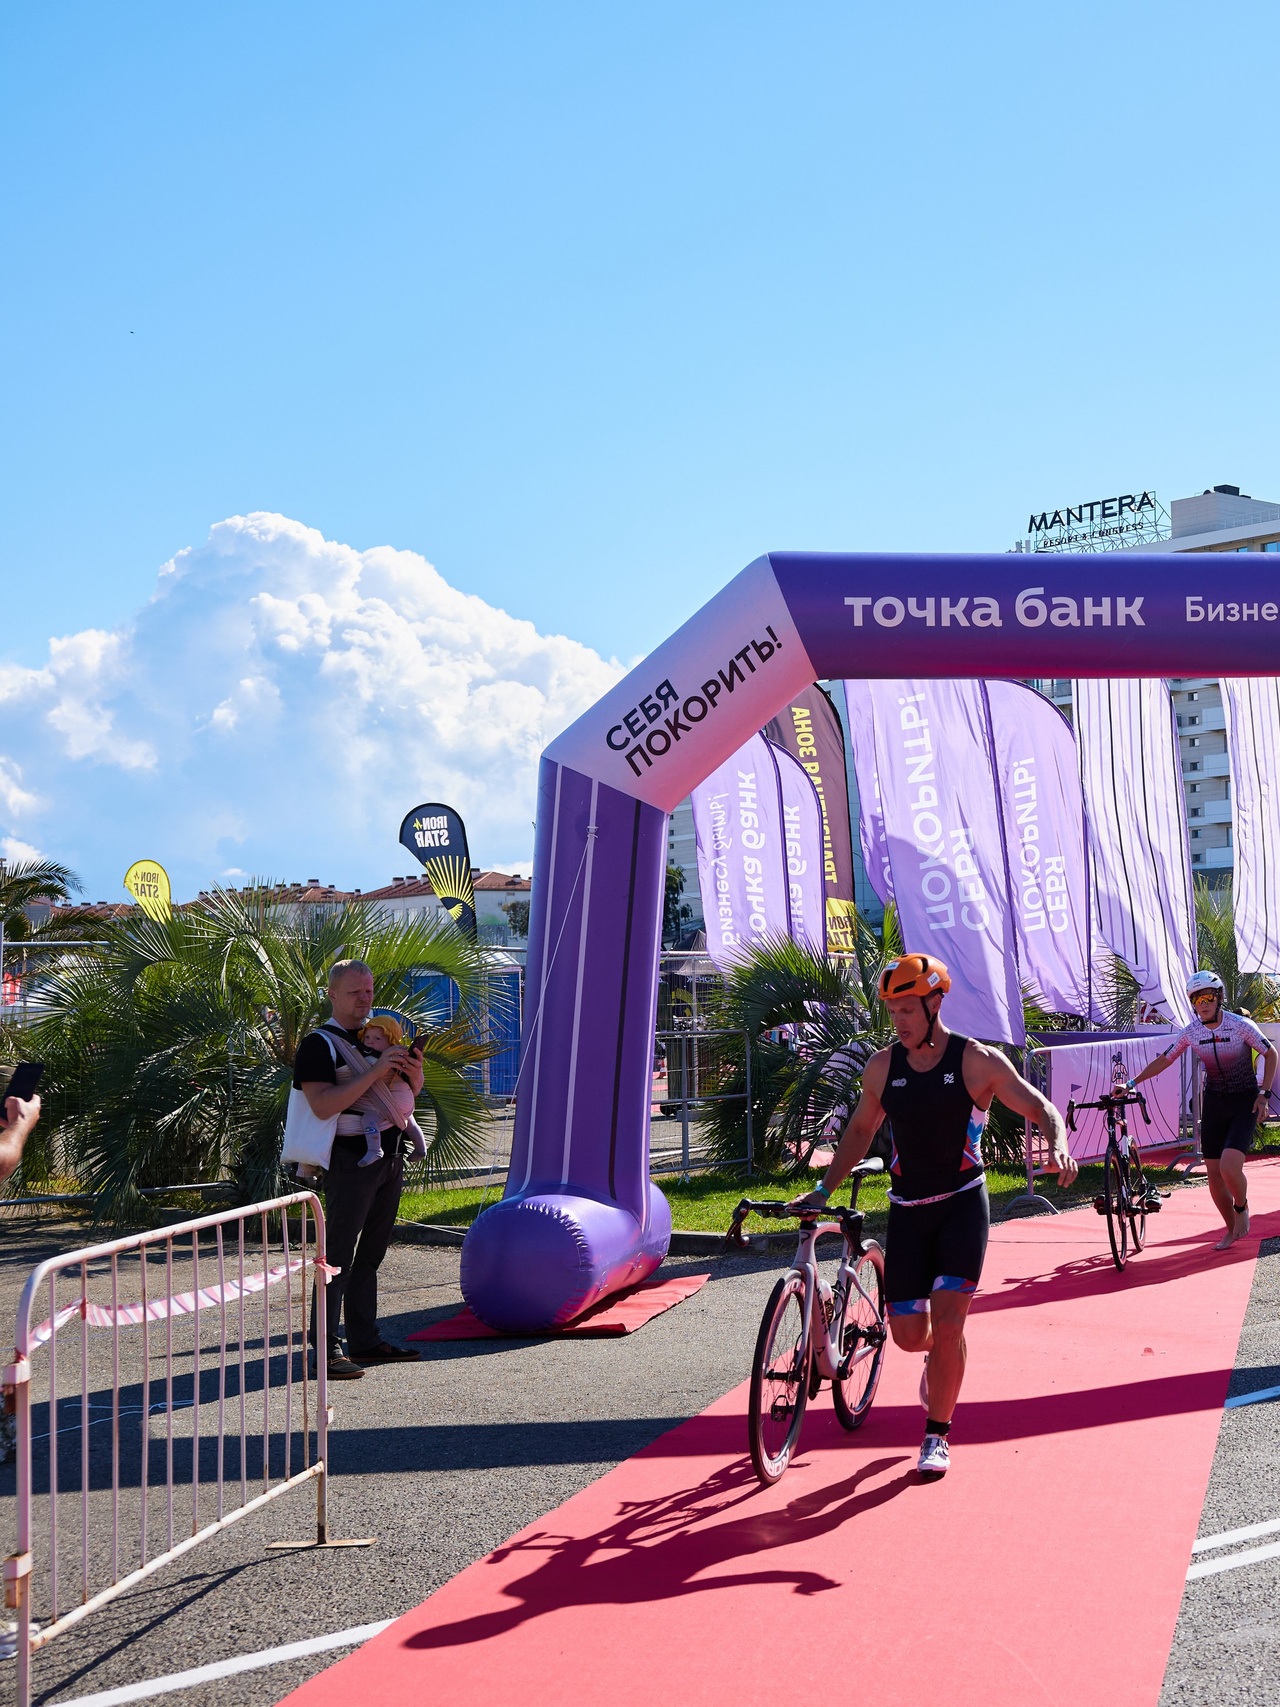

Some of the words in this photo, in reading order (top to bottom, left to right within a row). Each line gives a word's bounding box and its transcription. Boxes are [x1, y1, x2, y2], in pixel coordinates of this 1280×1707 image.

[1028, 491, 1154, 533] MANTERA
[1043, 534, 1079, 548] RESORT
[844, 595, 1002, 628] точка
[1015, 587, 1146, 628] банк
[605, 679, 680, 753] СЕБЯ
[625, 624, 784, 778] ПОКОРИТЬ!
